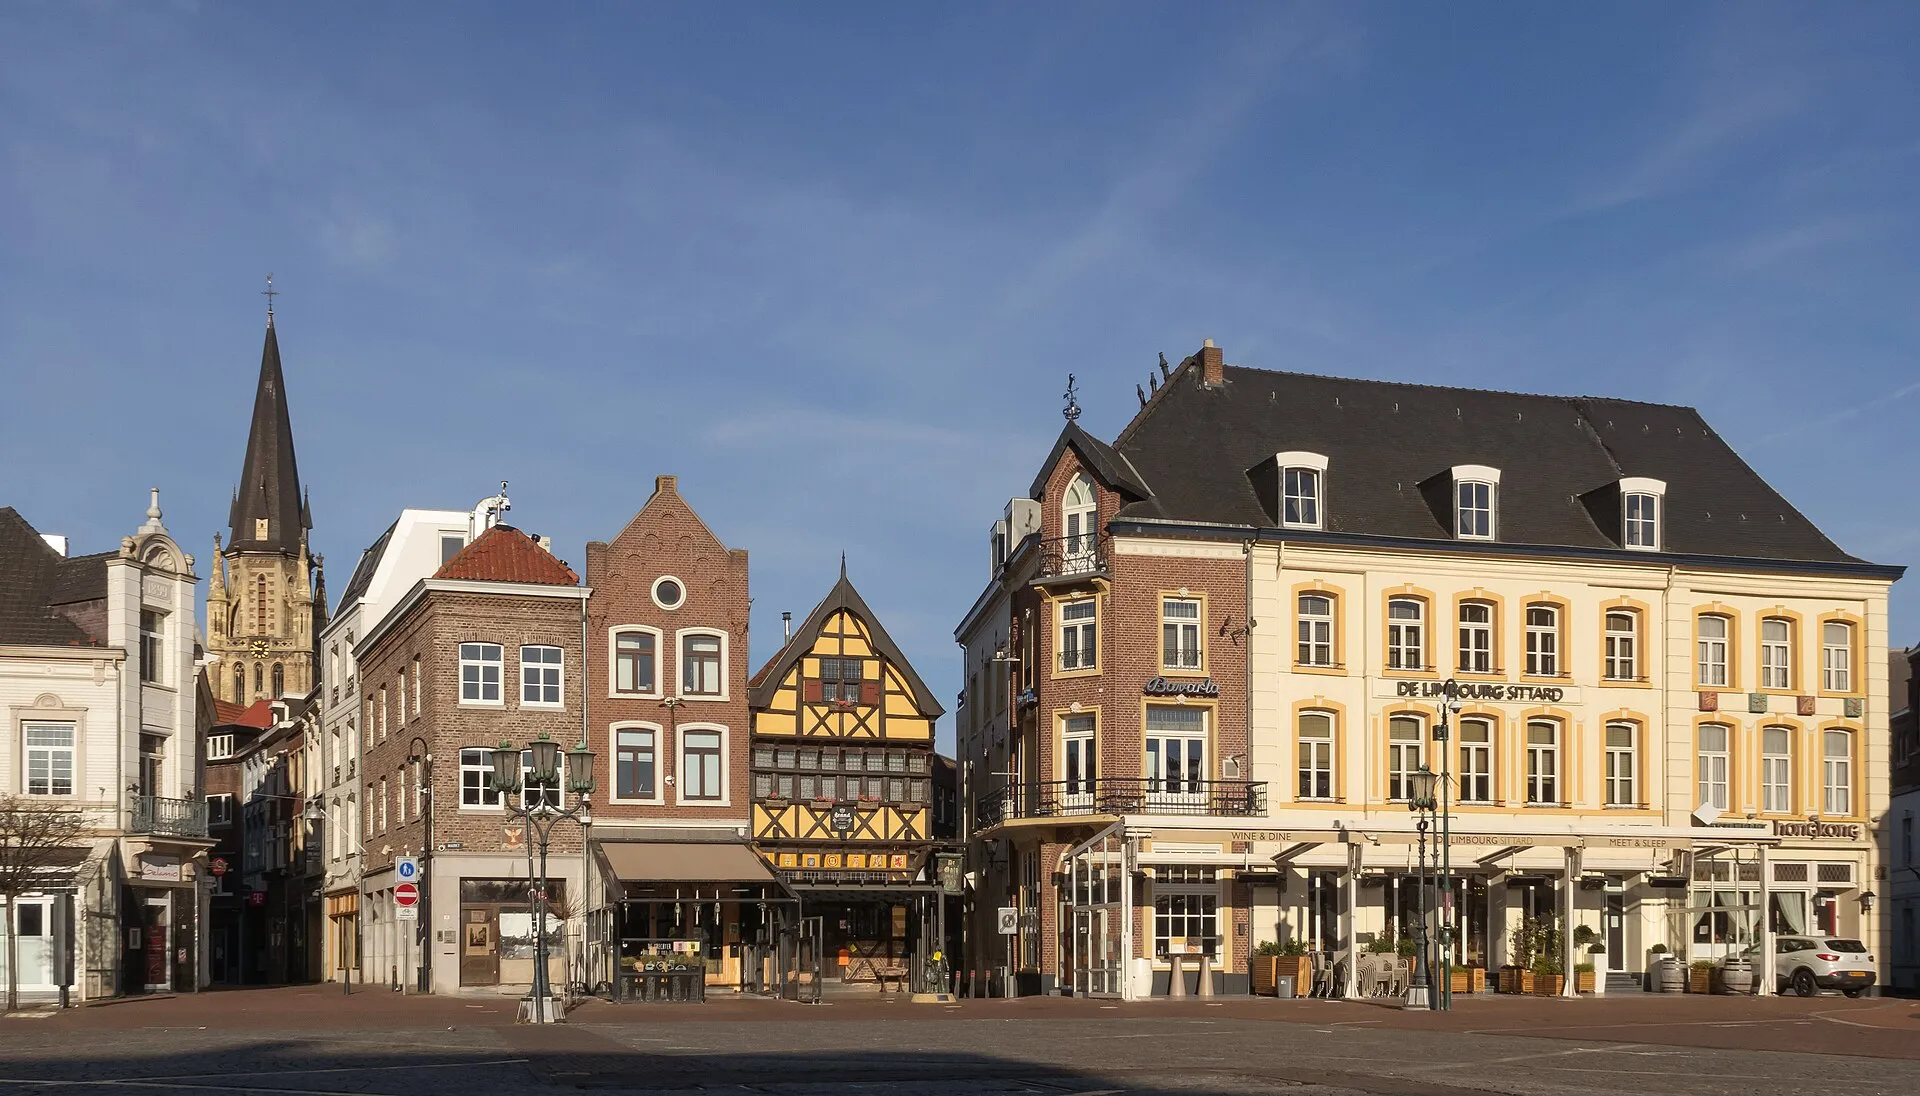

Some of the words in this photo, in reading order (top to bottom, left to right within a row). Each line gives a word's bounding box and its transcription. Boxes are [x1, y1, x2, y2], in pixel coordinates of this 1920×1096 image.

[1144, 677, 1219, 695] Bavaria
[1397, 682, 1418, 696] DE
[1507, 686, 1564, 702] SITTARD
[1231, 832, 1256, 841] WINE
[1260, 832, 1266, 841] &
[1269, 832, 1292, 841] DINE
[1773, 820, 1859, 841] hongkong
[1450, 835, 1498, 844] LIMBOURG
[1500, 836, 1534, 845] SITTARD
[1609, 839, 1633, 847] MEET
[1635, 839, 1640, 847] &
[1643, 839, 1667, 848] SLEEP
